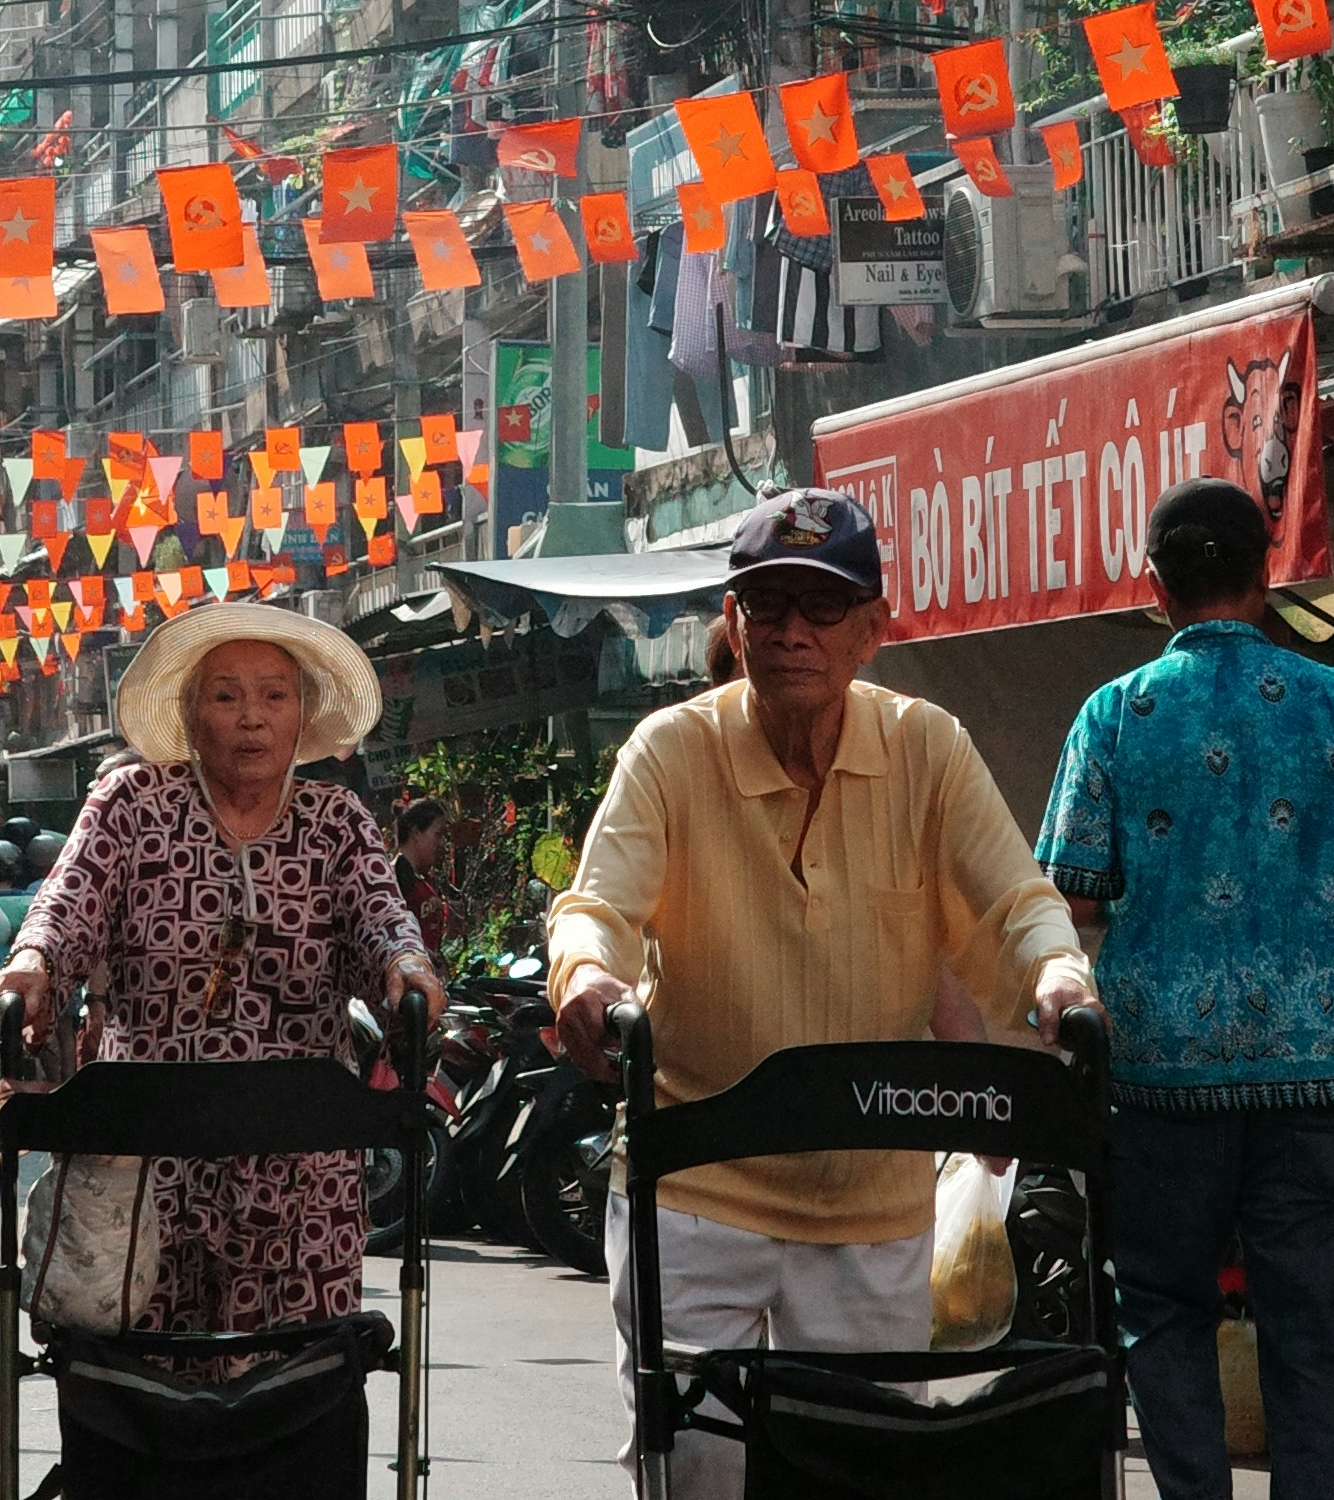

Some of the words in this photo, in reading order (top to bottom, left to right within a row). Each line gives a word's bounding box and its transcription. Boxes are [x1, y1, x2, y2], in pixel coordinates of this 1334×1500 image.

[893, 226, 940, 246] Tattoo
[865, 263, 895, 283] Nail
[900, 267, 909, 282] &
[911, 447, 950, 612] BÒ
[962, 436, 1012, 604] BÍT
[1023, 398, 1086, 593] TẾT
[1100, 398, 1145, 582] CÔ
